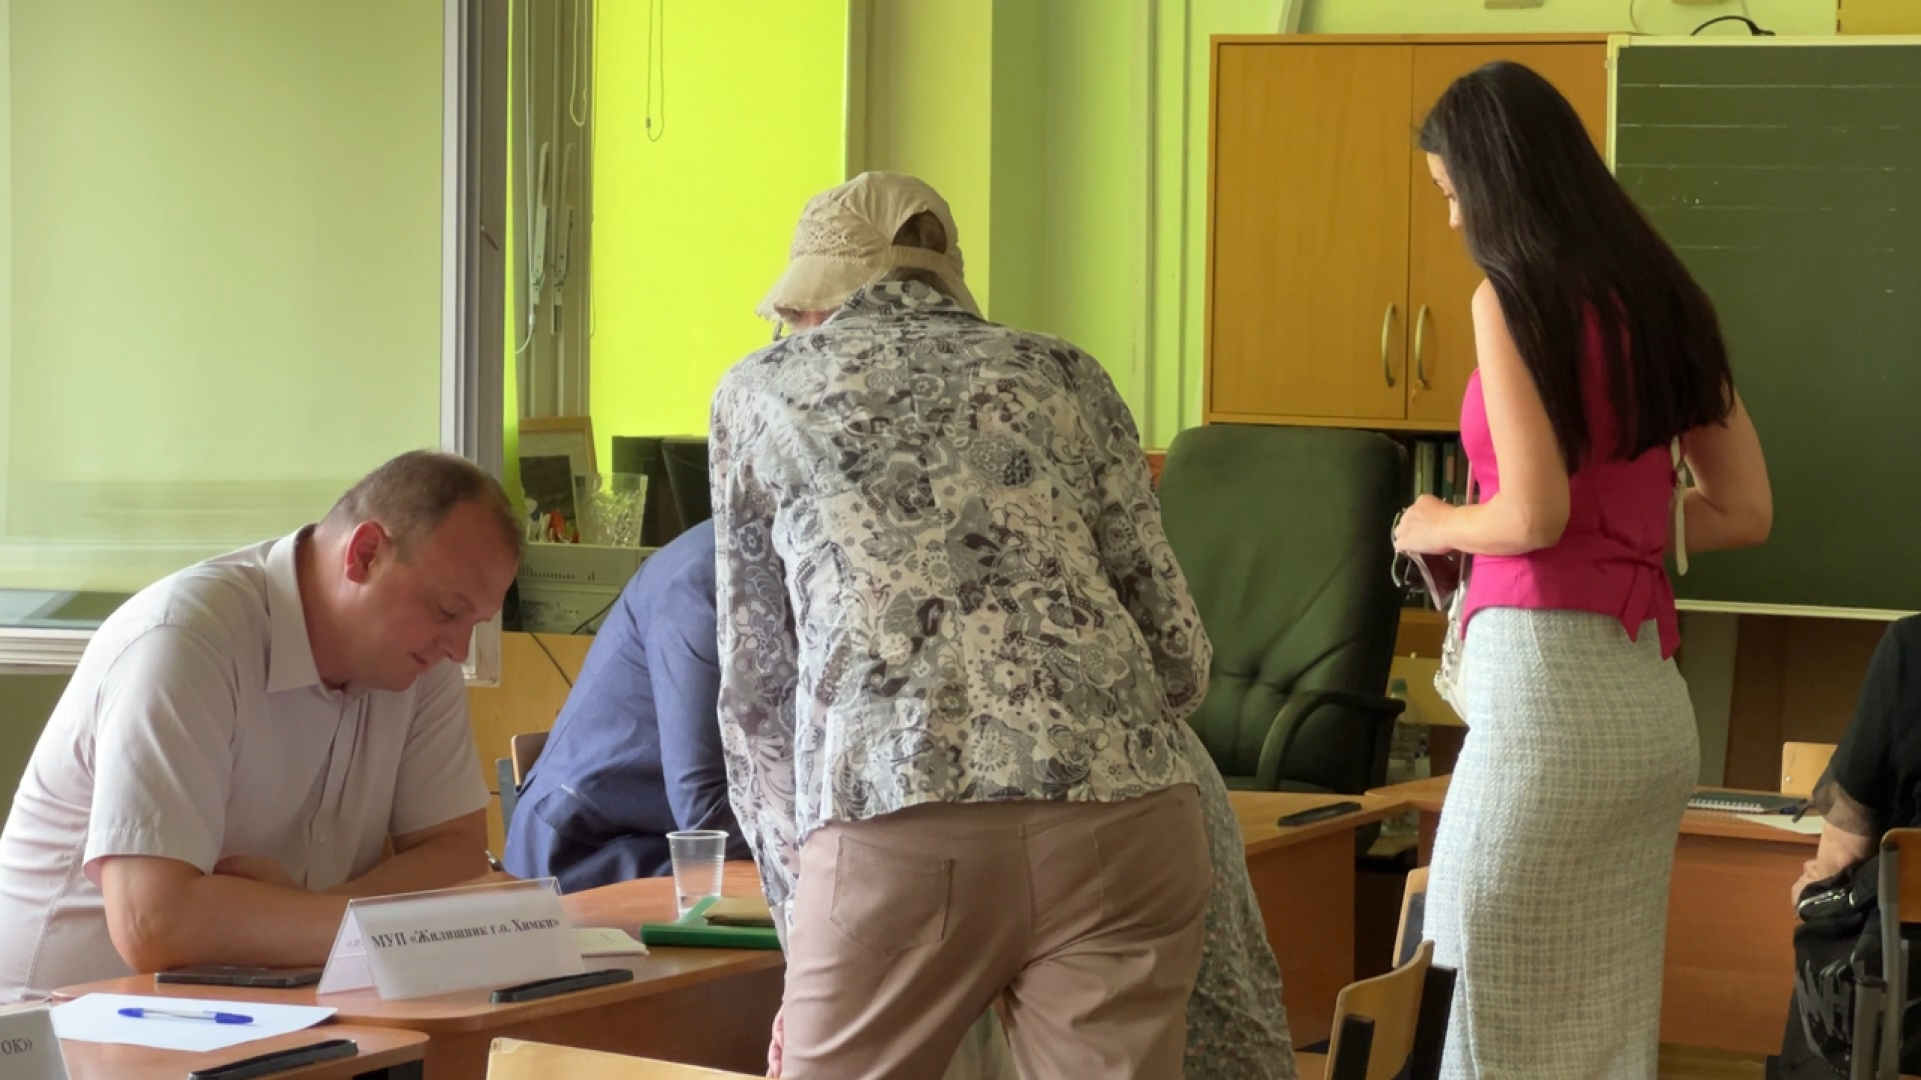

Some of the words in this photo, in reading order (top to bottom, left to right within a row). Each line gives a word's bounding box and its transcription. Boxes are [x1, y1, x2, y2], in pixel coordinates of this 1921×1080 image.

[371, 932, 407, 949] МУП
[489, 924, 511, 935] г.о.
[511, 918, 560, 932] Химки»
[0, 1037, 33, 1056] ОК»
